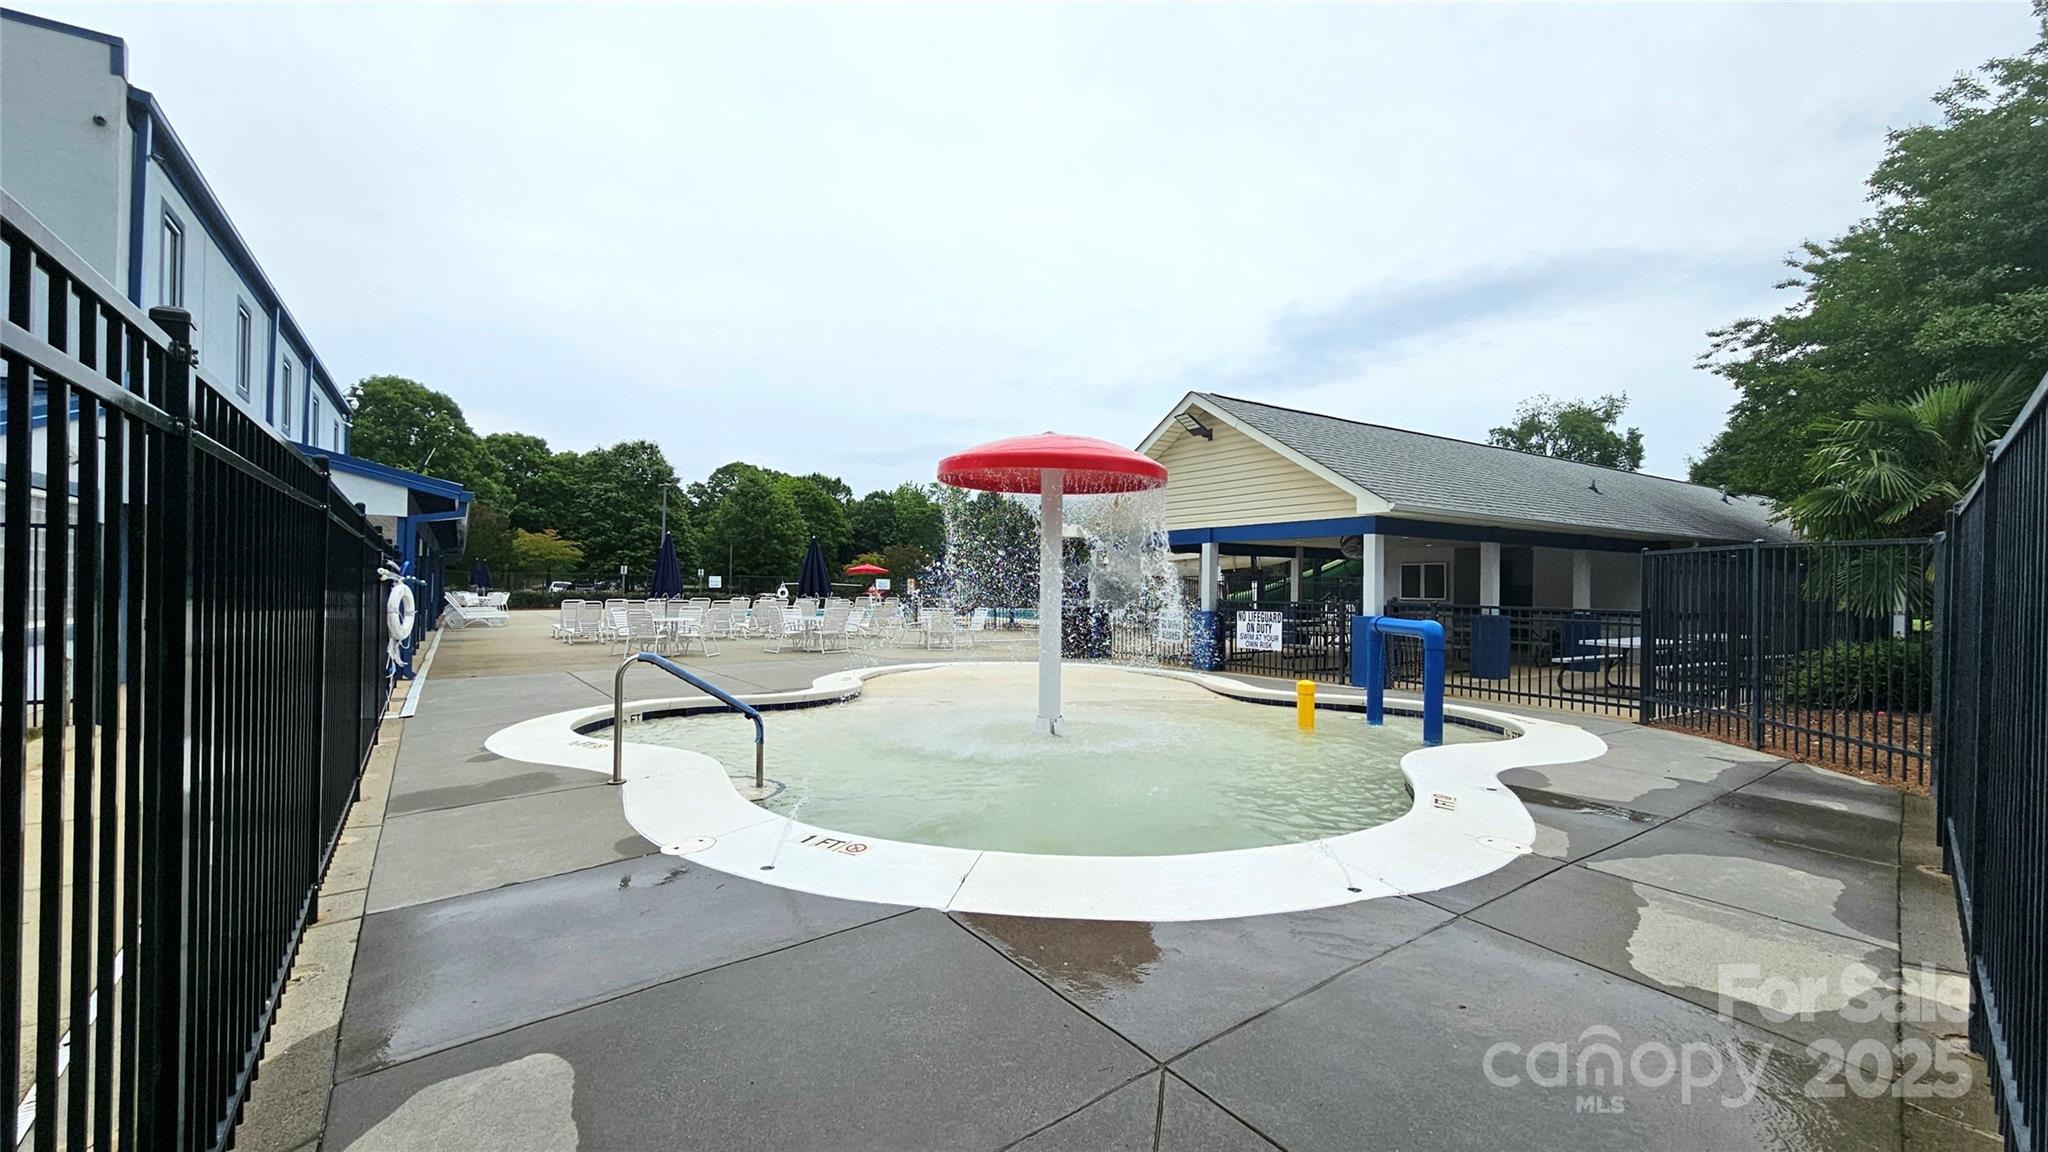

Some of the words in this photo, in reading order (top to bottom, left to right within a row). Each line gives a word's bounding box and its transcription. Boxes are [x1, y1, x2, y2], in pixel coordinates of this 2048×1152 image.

[1238, 611, 1247, 622] NO
[1248, 612, 1281, 623] LIFEGUARD
[1246, 622, 1255, 633] ON
[1256, 623, 1272, 634] DUTY
[1259, 641, 1273, 649] RISK
[800, 835, 817, 843] 1
[814, 837, 846, 849] FT
